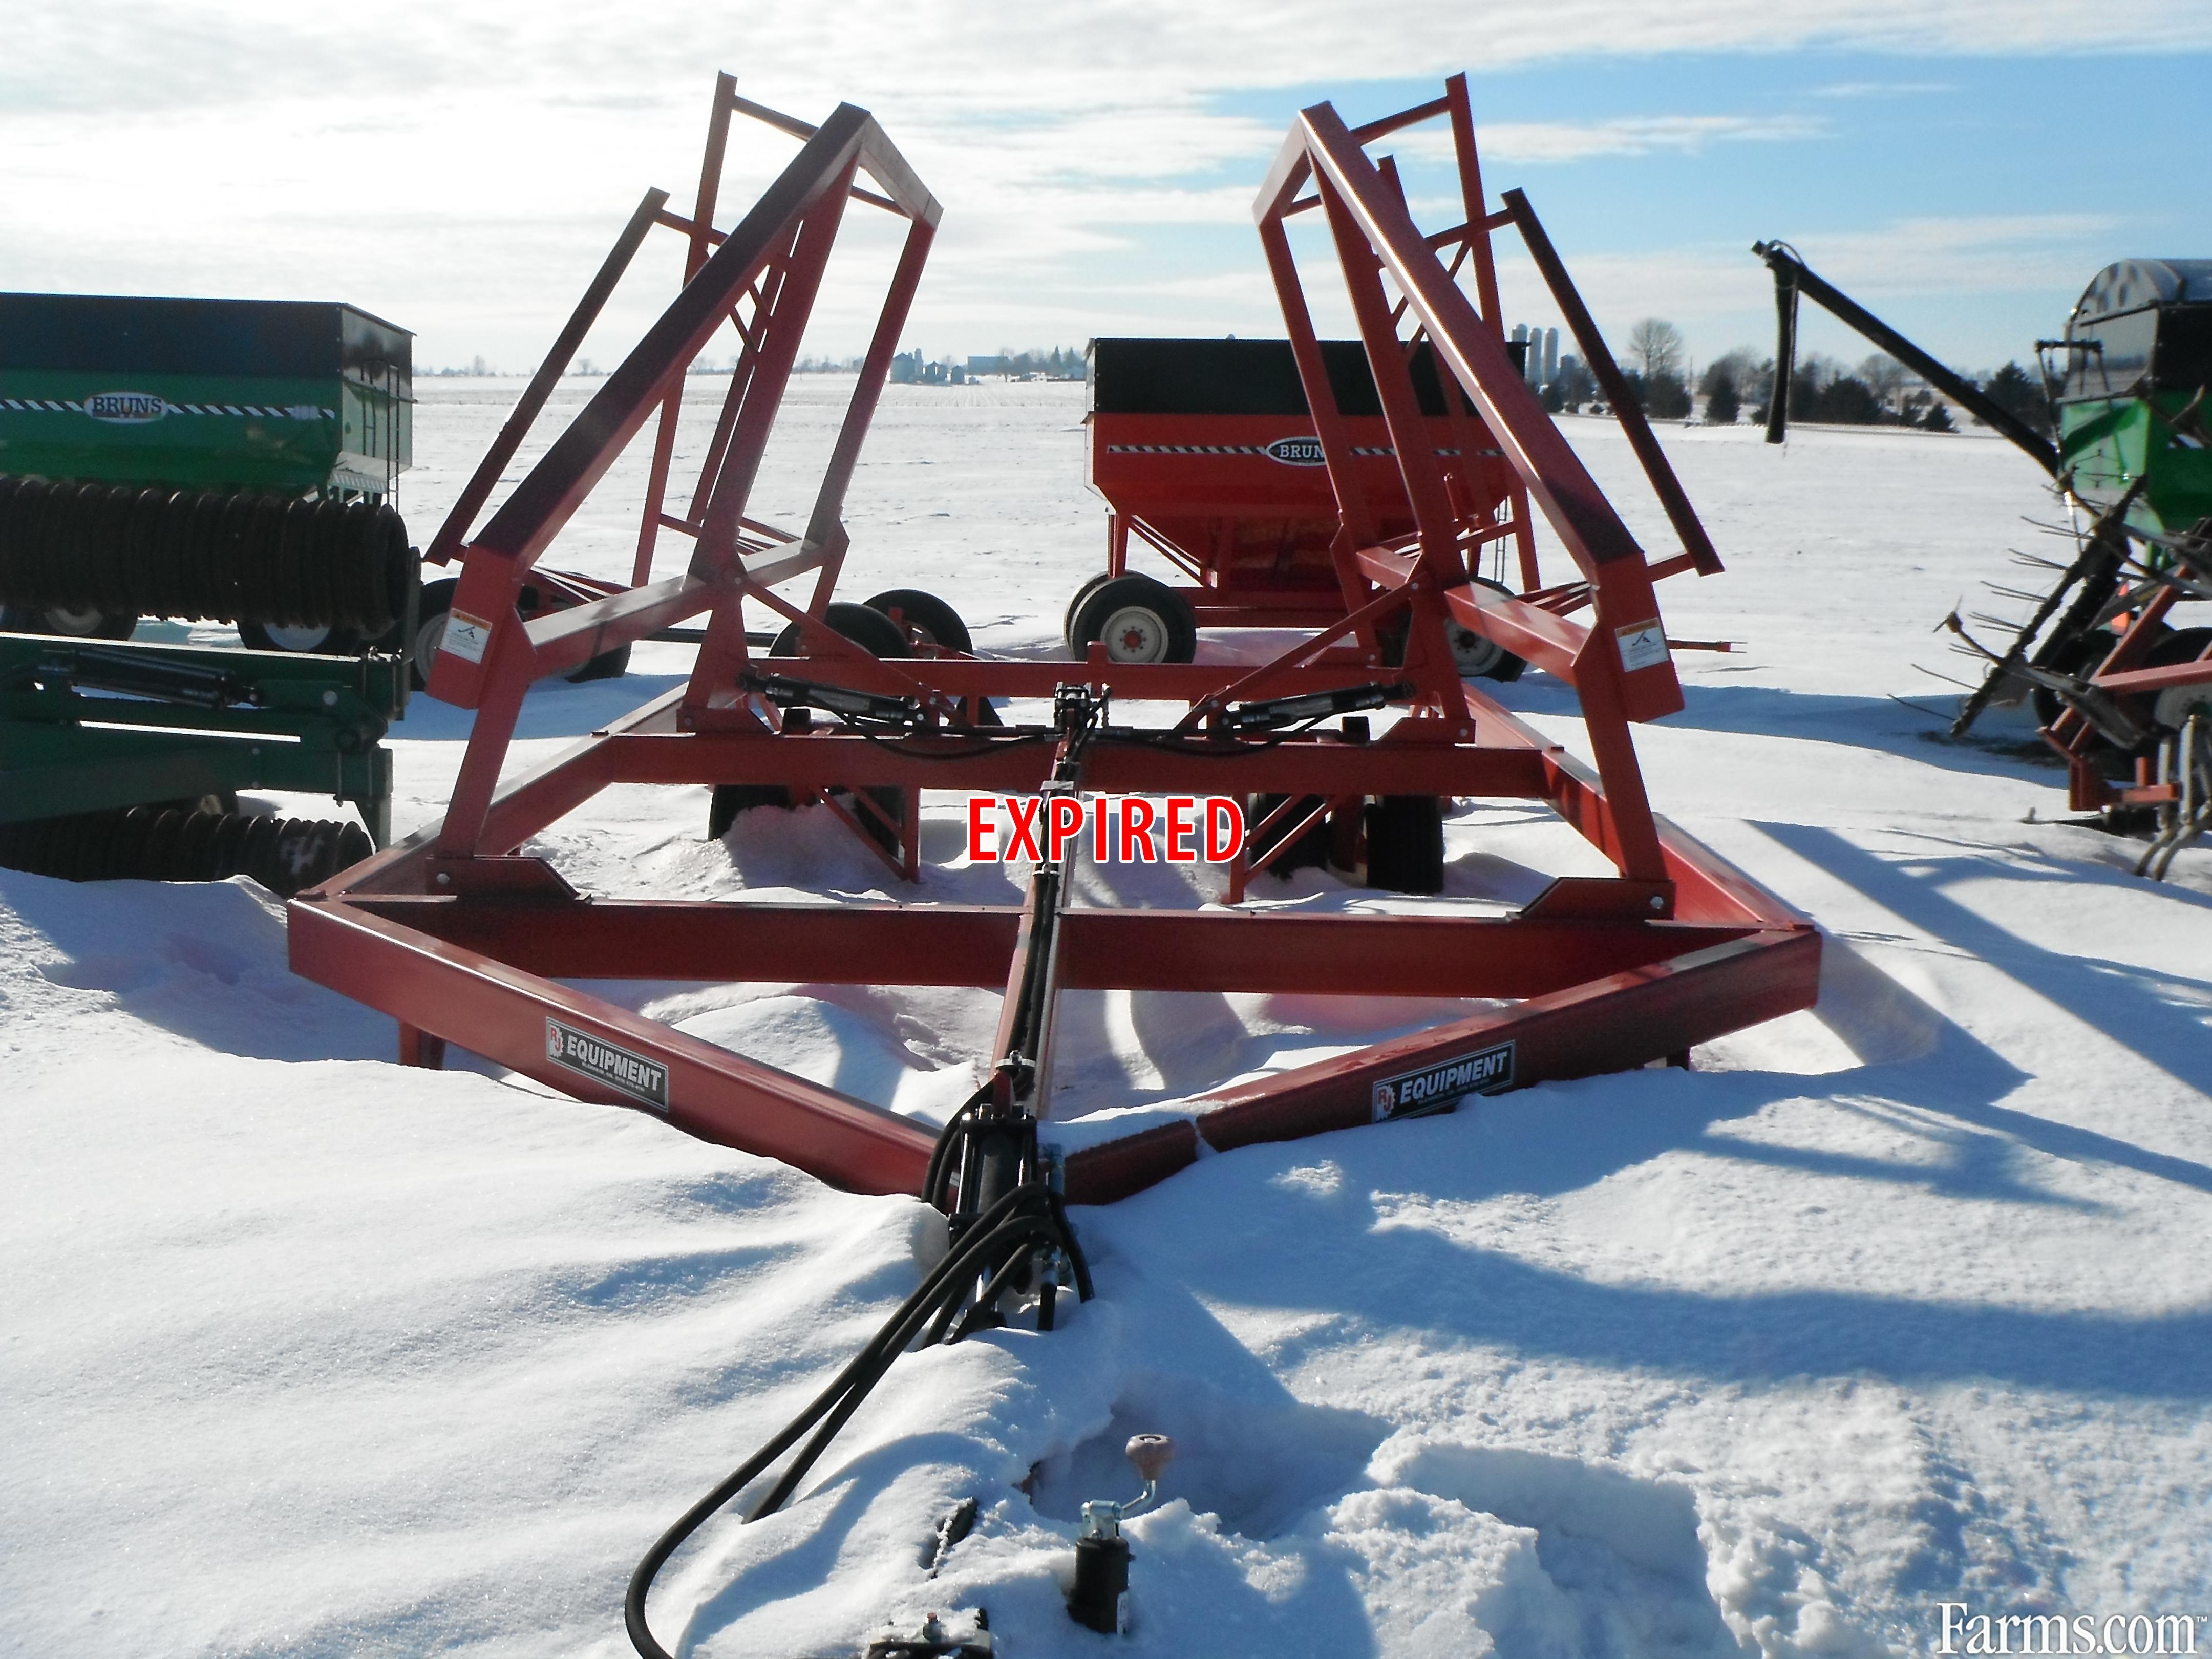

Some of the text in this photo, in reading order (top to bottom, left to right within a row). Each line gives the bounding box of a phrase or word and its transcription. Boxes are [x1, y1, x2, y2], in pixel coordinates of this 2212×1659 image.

[92, 396, 162, 414] BRUNS
[1279, 444, 1325, 458] BRUN
[567, 1035, 662, 1091] EQUIPMENT
[1399, 1051, 1508, 1103] EQUIPMENT
